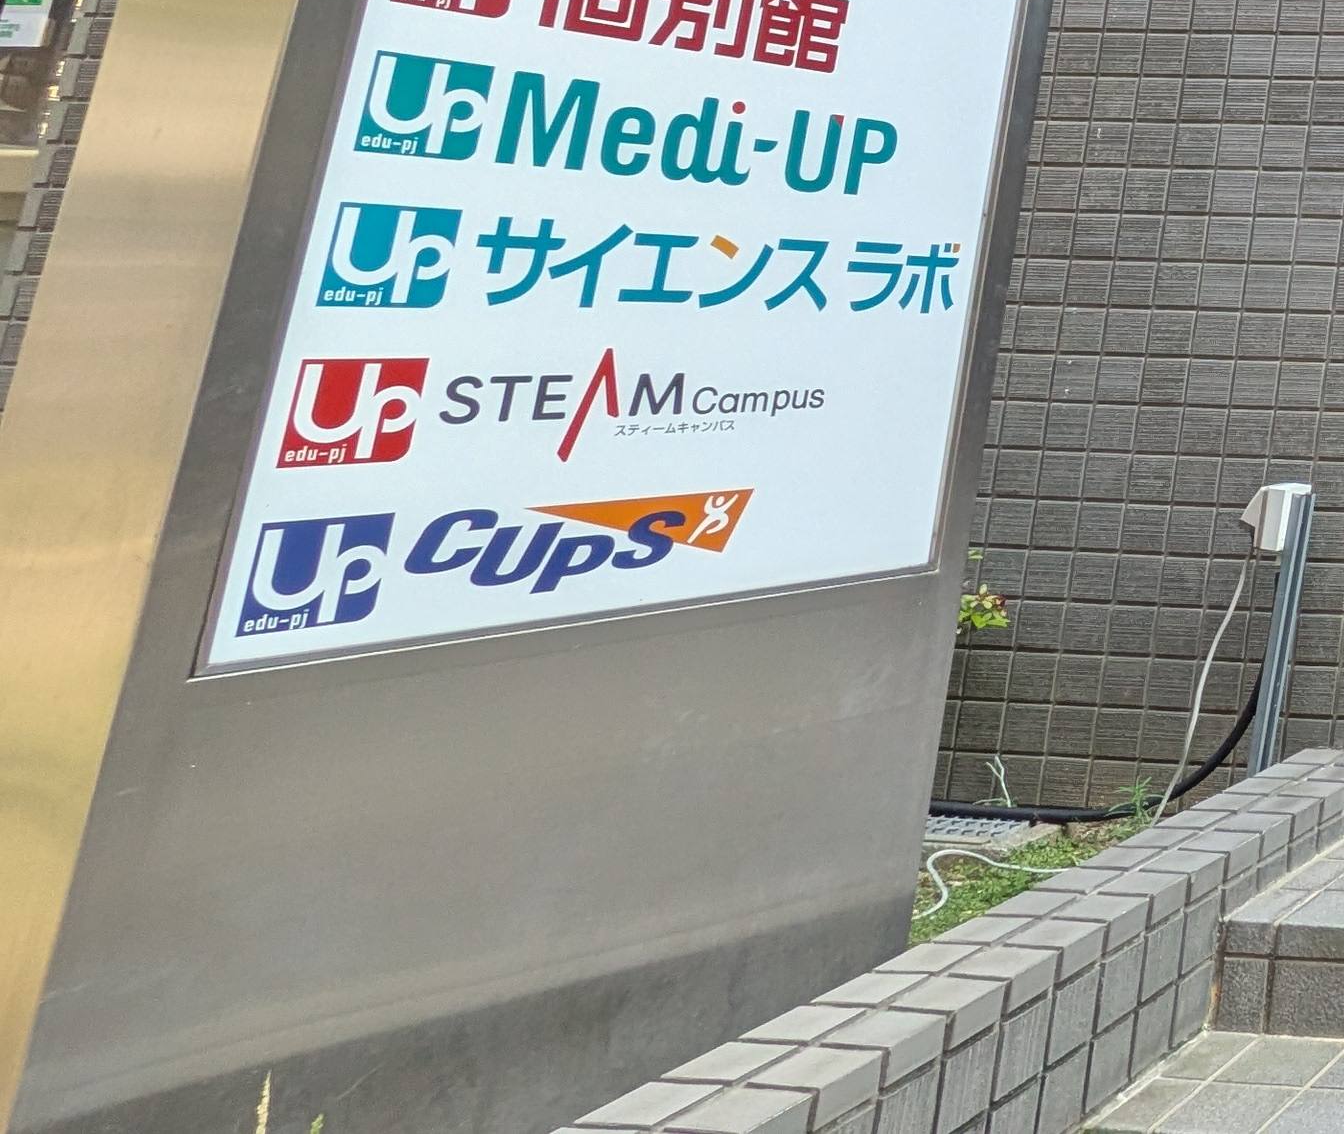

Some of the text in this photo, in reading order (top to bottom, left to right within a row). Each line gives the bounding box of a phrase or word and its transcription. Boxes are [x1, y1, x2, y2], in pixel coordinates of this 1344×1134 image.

[495, 70, 899, 196] Medi-UP
[438, 348, 686, 463] STEAM
[692, 386, 826, 417] Campus
